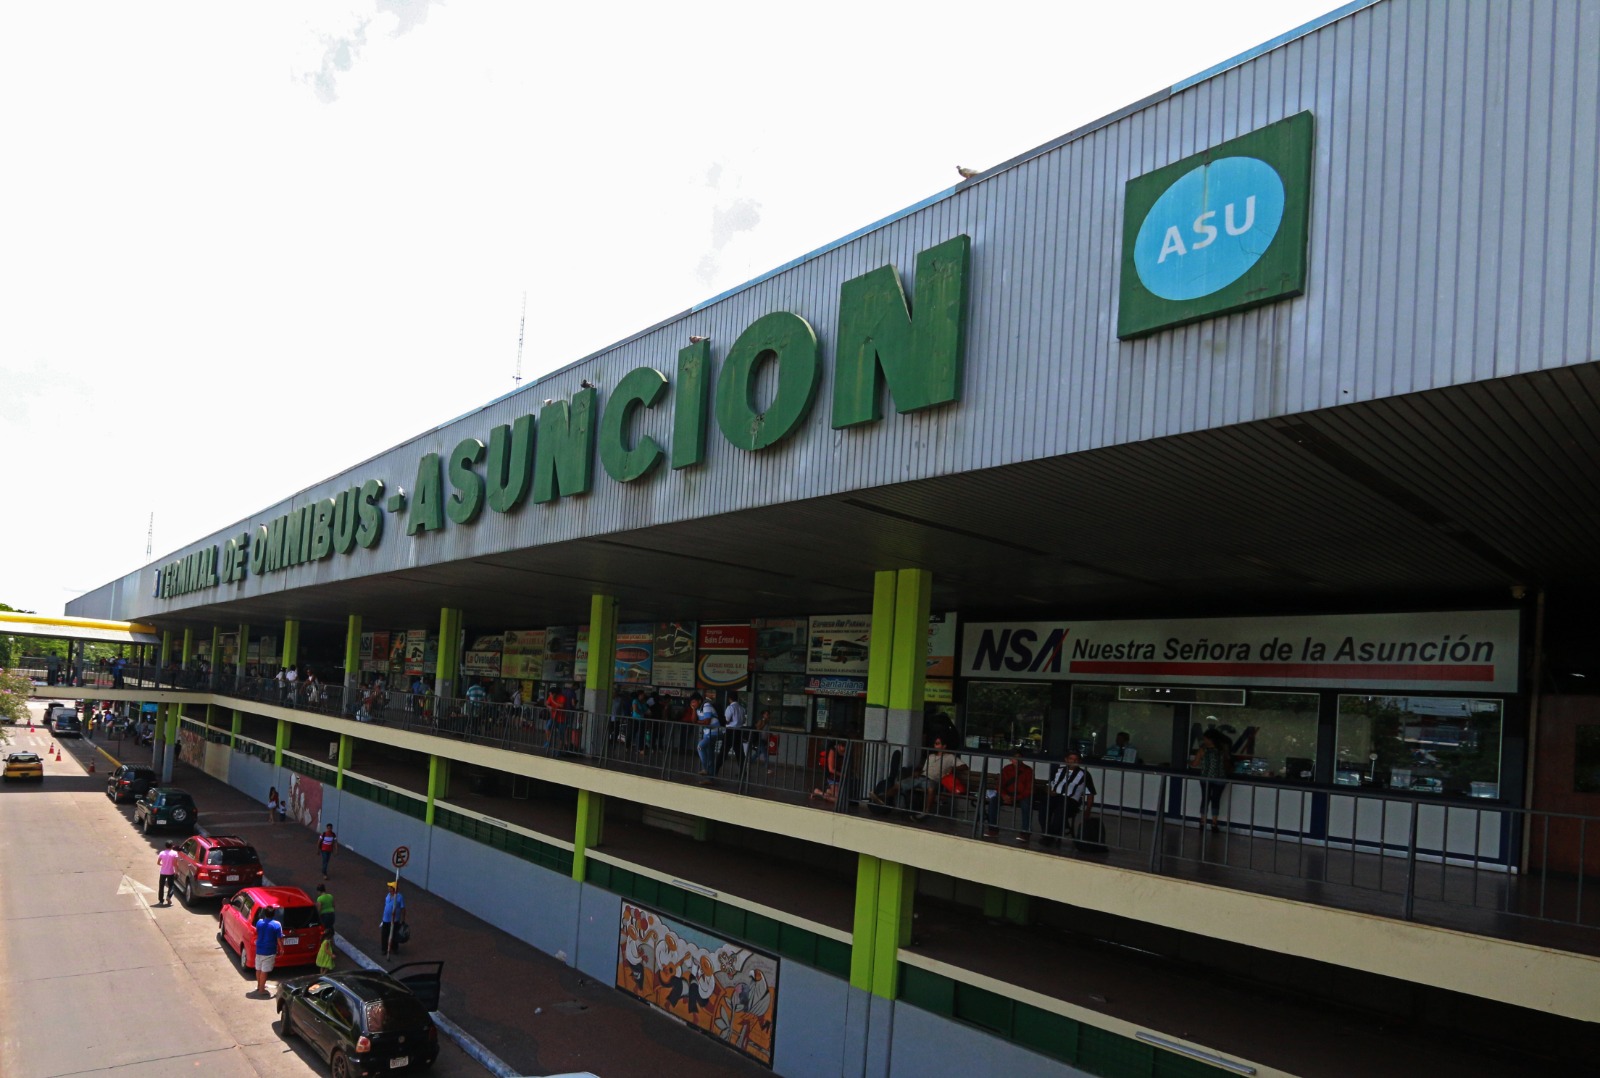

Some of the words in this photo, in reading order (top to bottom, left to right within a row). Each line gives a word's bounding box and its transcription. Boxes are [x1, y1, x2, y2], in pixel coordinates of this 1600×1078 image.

[1157, 194, 1257, 264] ASU
[159, 544, 218, 599] TERMINAL
[221, 531, 248, 584] DE
[251, 478, 385, 576] OMNIBUS
[972, 627, 1069, 673] NSA
[1072, 639, 1156, 661] Nuestra
[1163, 637, 1251, 662] Señora
[1259, 637, 1293, 662] de
[1301, 636, 1325, 662] la
[1333, 633, 1494, 663] Asunción
[810, 677, 820, 688] La
